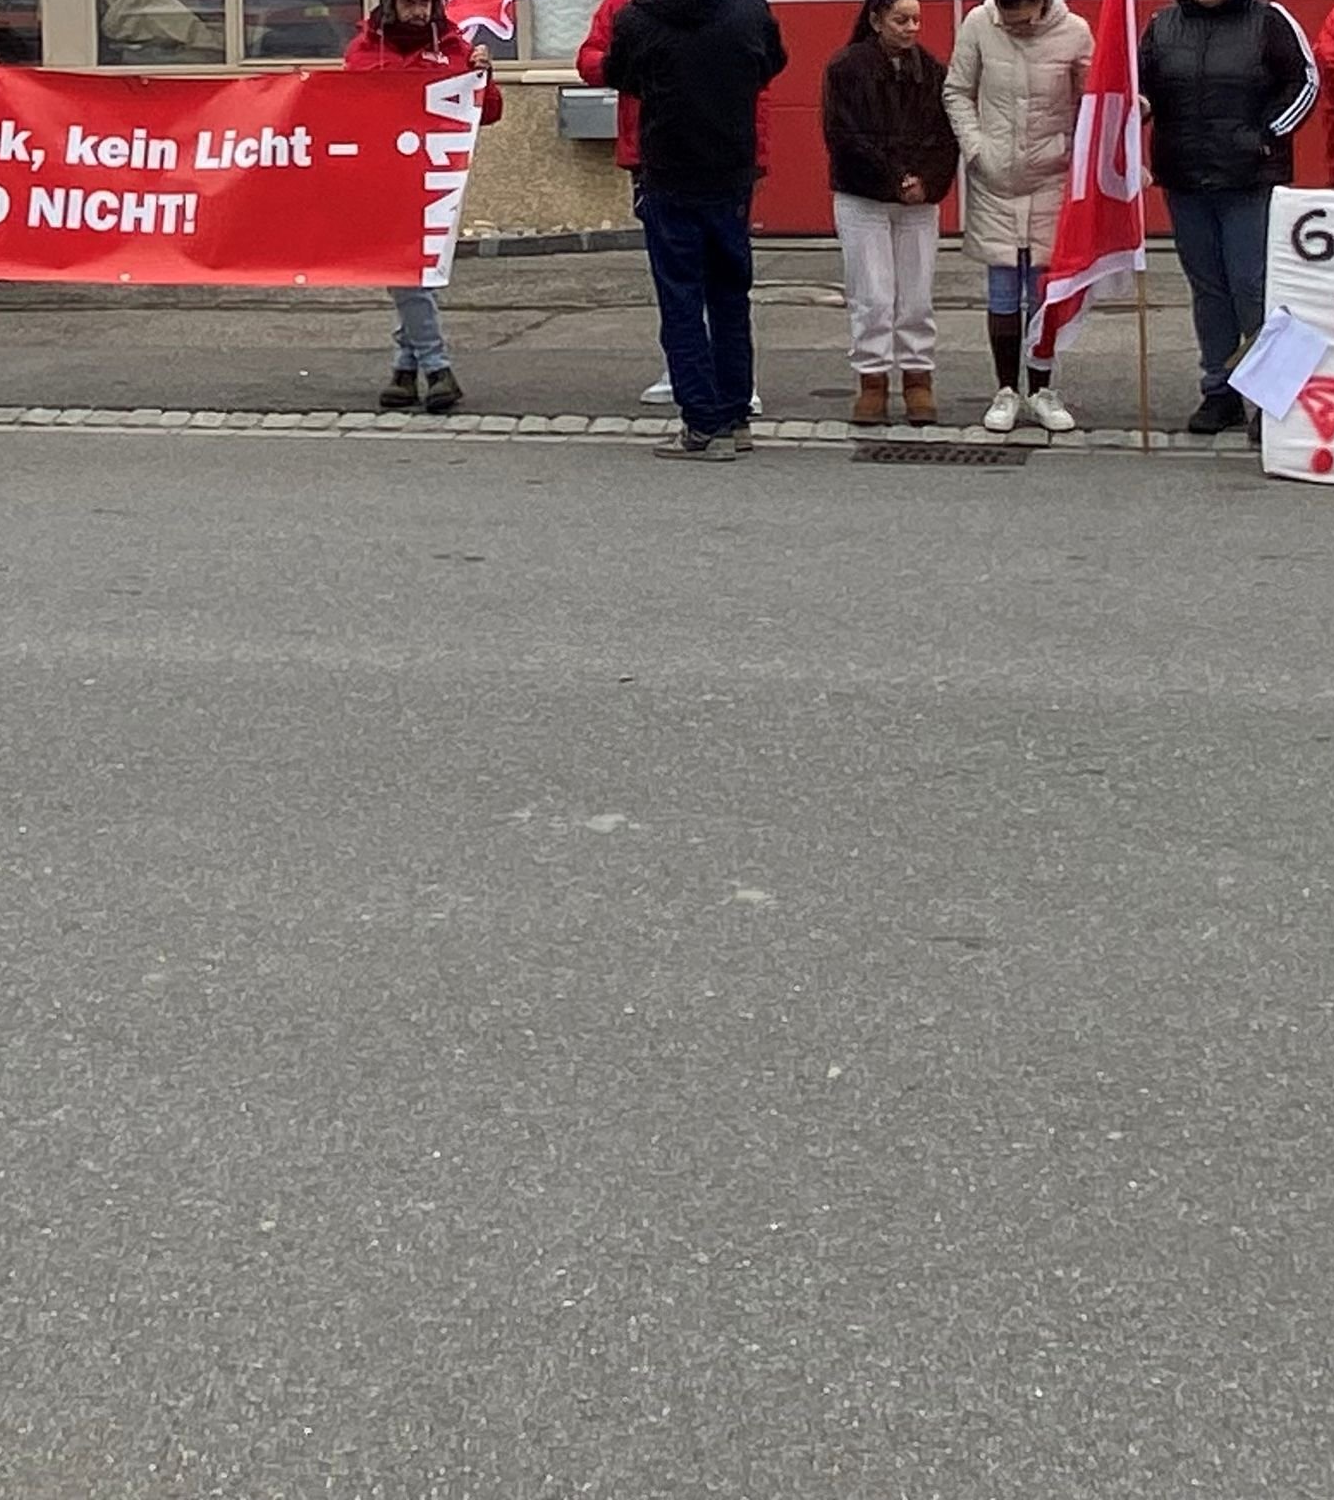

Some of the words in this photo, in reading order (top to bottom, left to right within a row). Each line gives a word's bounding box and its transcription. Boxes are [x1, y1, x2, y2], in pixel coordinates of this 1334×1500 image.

[66, 125, 178, 169] kein
[195, 126, 312, 170] Licht
[27, 186, 198, 235] NICHT!
